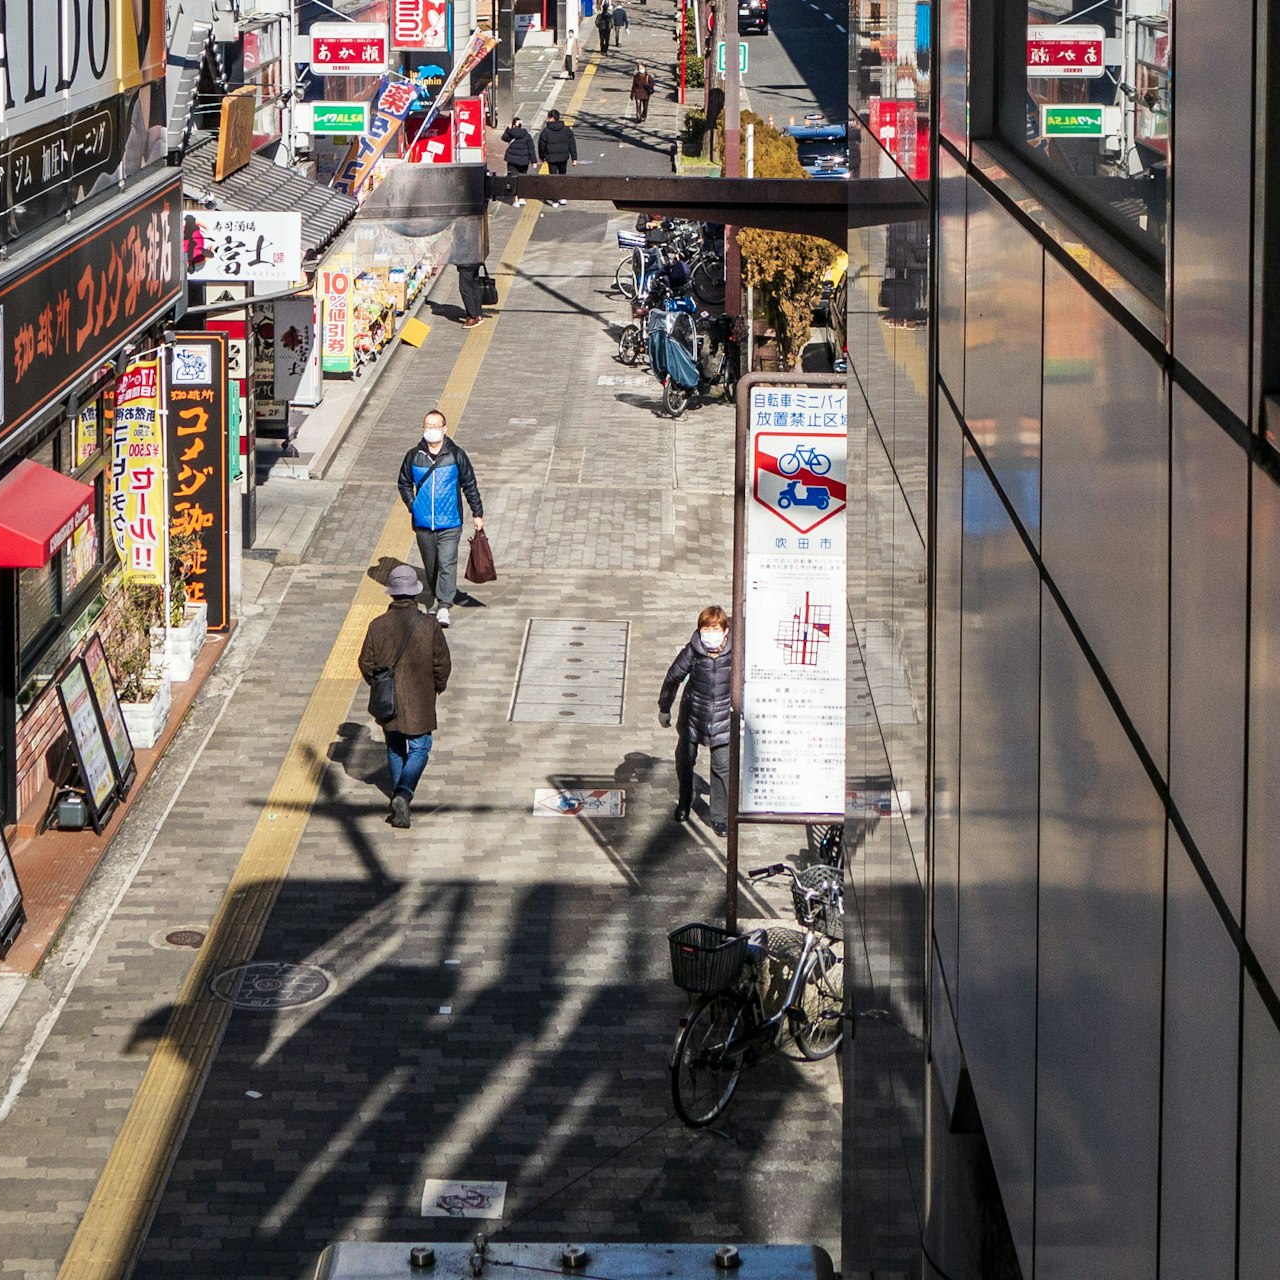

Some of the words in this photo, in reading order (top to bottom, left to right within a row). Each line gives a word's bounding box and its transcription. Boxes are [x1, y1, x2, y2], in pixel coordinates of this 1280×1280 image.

[318, 44, 380, 62] あか瀬
[15, 154, 32, 192] ジム
[41, 121, 106, 183] 加圧トレーニング
[213, 221, 256, 232] 寿司酒場
[14, 289, 71, 385] 珈琲所
[76, 201, 172, 353] コメダ珈琲店
[171, 390, 214, 402] 珈琲所
[268, 409, 280, 417] 2F
[775, 537, 832, 550] 吹田市
